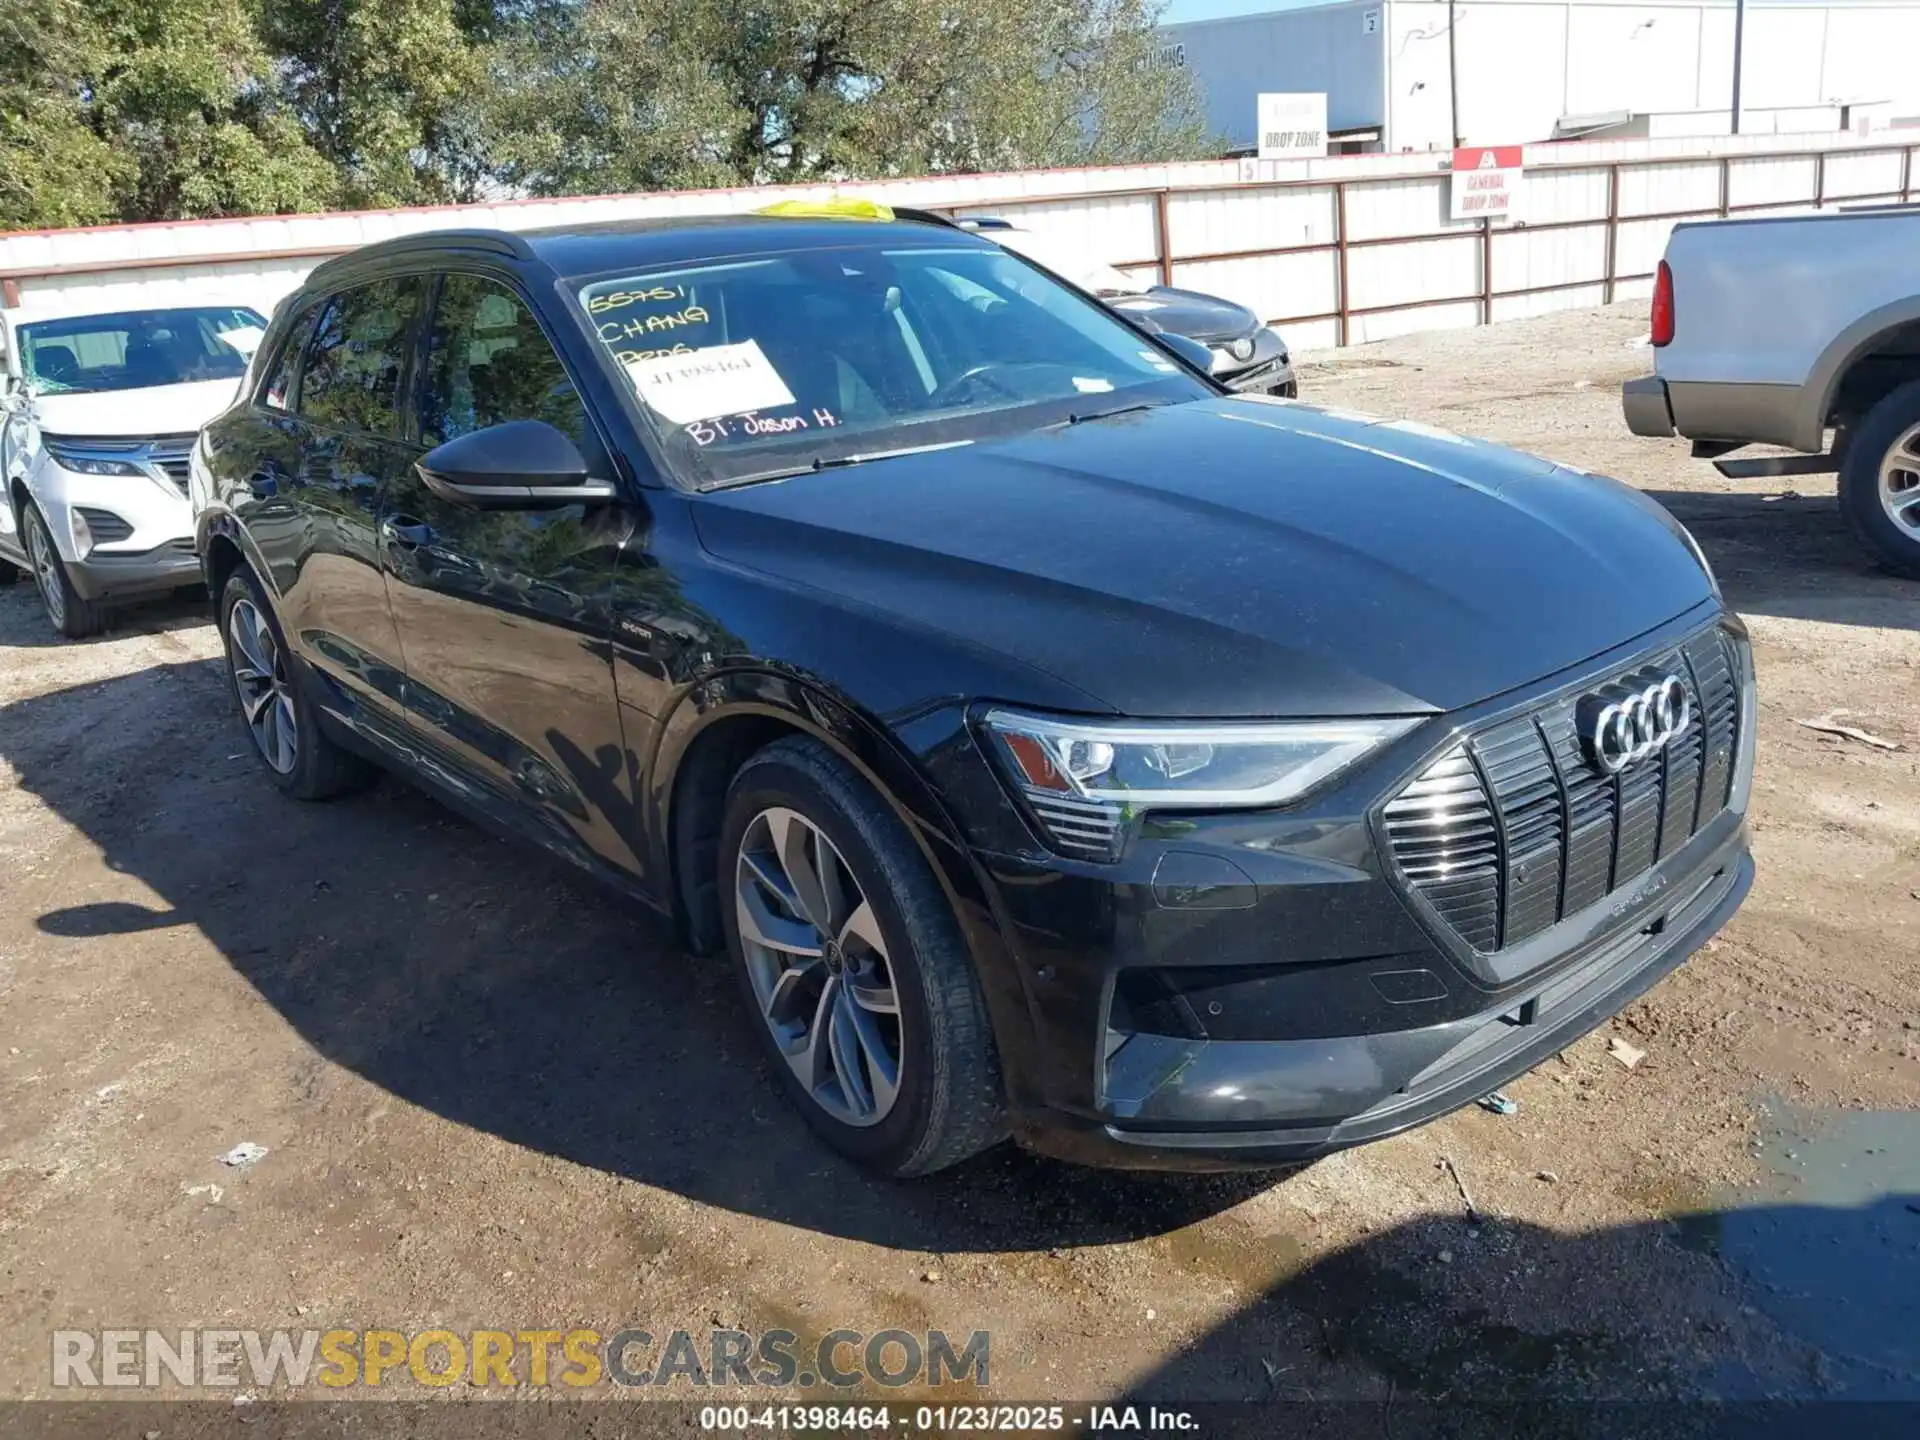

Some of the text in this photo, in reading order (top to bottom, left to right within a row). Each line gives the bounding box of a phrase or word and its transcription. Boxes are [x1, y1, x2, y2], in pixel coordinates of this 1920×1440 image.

[1264, 130, 1321, 148] DROP ZONE
[1462, 194, 1487, 212] DROP
[735, 411, 808, 435] Jason
